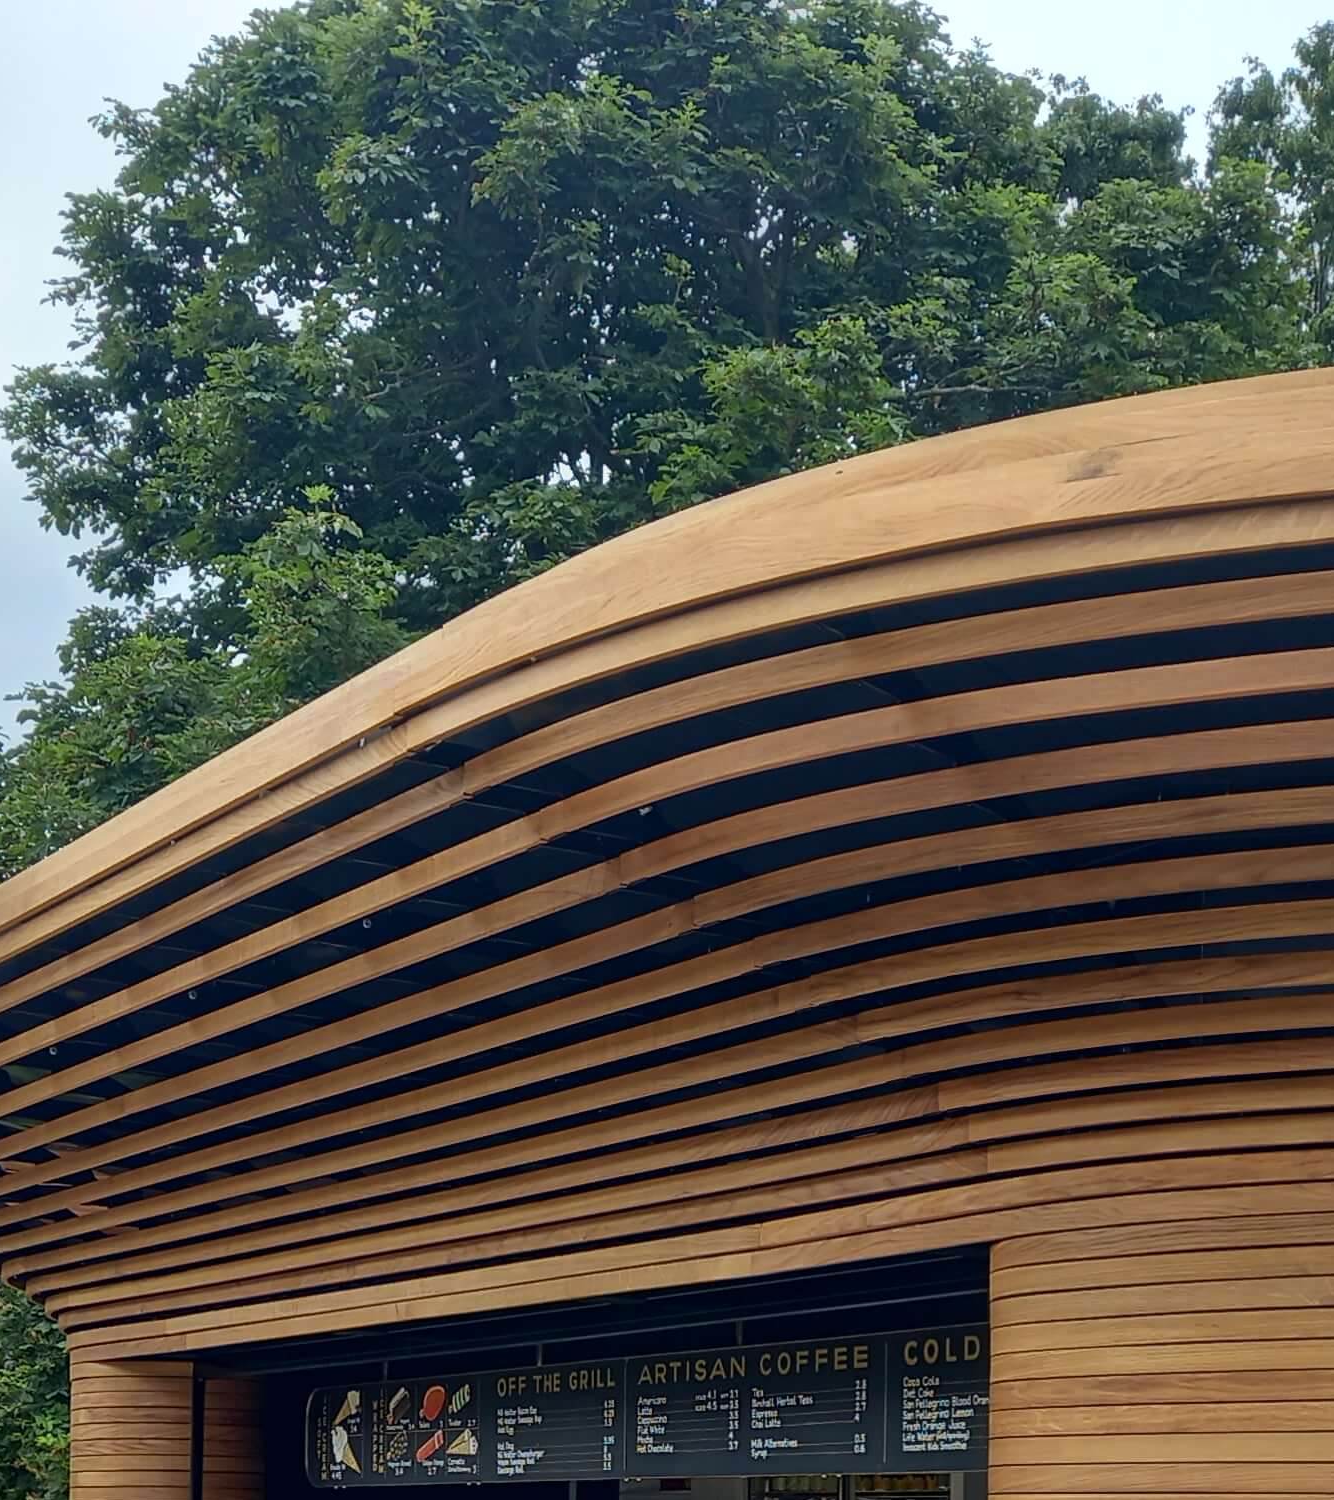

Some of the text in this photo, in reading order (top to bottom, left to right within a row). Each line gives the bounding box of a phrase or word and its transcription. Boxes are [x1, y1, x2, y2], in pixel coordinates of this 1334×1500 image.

[904, 1336, 980, 1365] COLD
[638, 1345, 868, 1384] ARTISAN COFFEE
[497, 1368, 615, 1397] OFF THE GRILL
[903, 1376, 939, 1387] Coca Cola
[903, 1388, 934, 1398] Diet Coke
[903, 1399, 915, 1409] San
[915, 1398, 949, 1410] Pellegrino
[952, 1396, 971, 1406] Blood
[903, 1408, 974, 1422] San Pellegrino Lemon
[903, 1419, 966, 1431] Fresh Orange Juice
